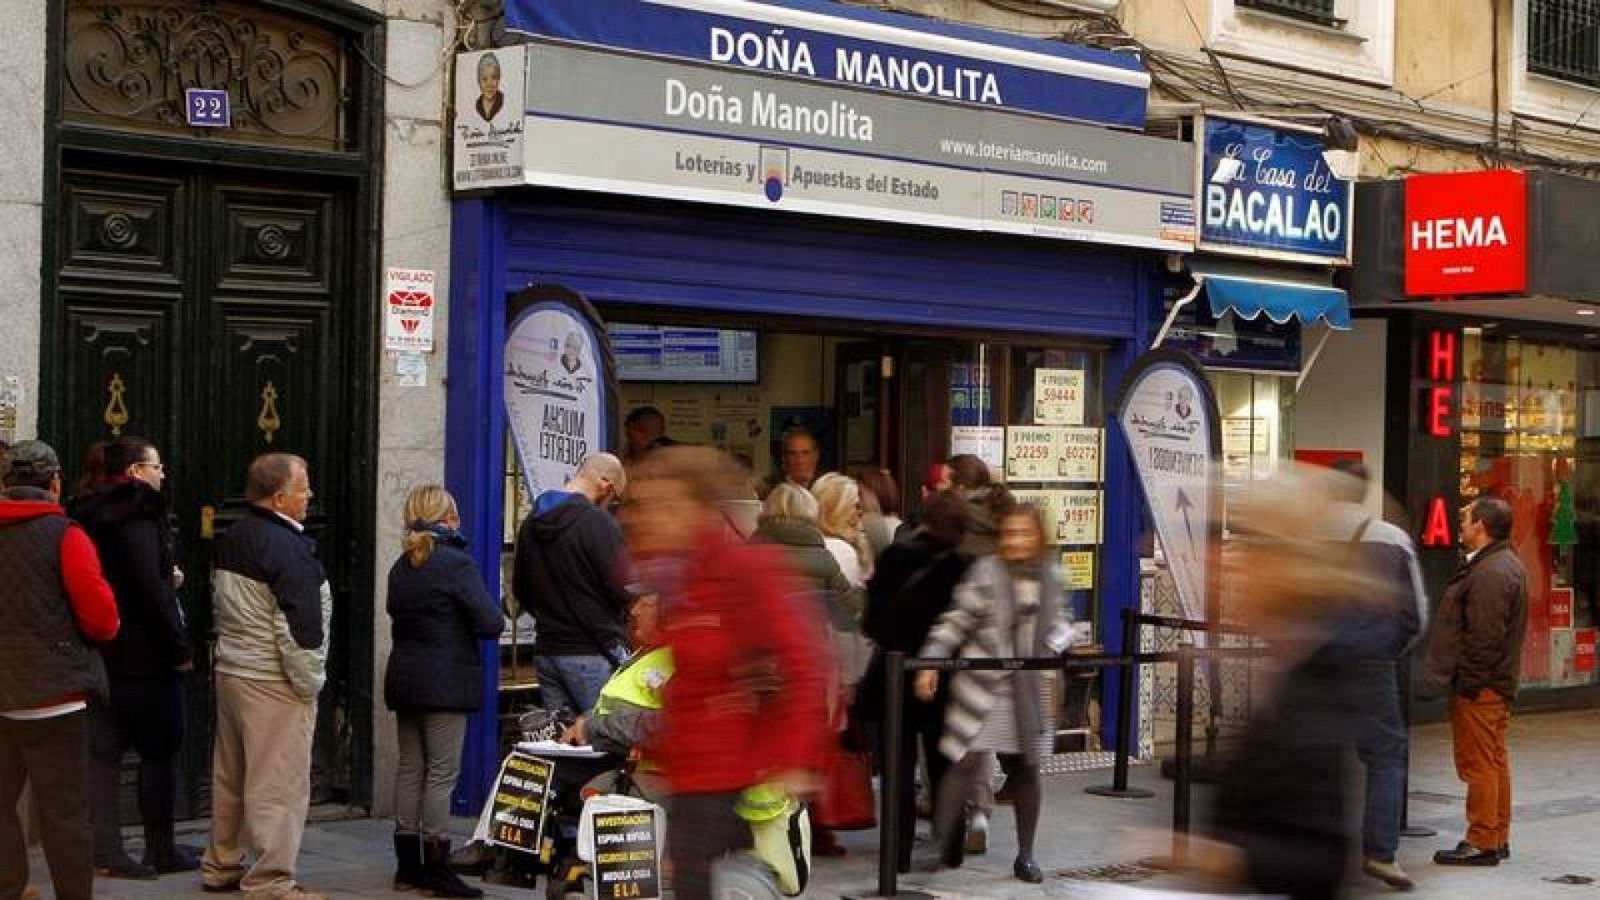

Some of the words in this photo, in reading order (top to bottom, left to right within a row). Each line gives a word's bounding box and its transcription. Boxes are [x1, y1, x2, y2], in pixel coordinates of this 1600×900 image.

[710, 27, 816, 76] DOÑA
[835, 48, 1003, 105] MANOLITA
[194, 97, 221, 119] 22
[664, 78, 743, 124] Doña
[751, 91, 874, 142] Manolita
[674, 150, 743, 178] Loterías
[743, 164, 757, 183] y
[791, 165, 862, 194] Apuestas
[865, 170, 888, 193] del
[890, 172, 939, 200] Estado
[939, 138, 1109, 175] www.loteriamanolita.com
[1253, 147, 1297, 188] Casa
[1304, 160, 1332, 193] del
[1205, 184, 1341, 241] BACALAO
[1411, 214, 1508, 250] HEMA
[500, 825, 522, 844] ELA
[613, 882, 641, 897] ELA
